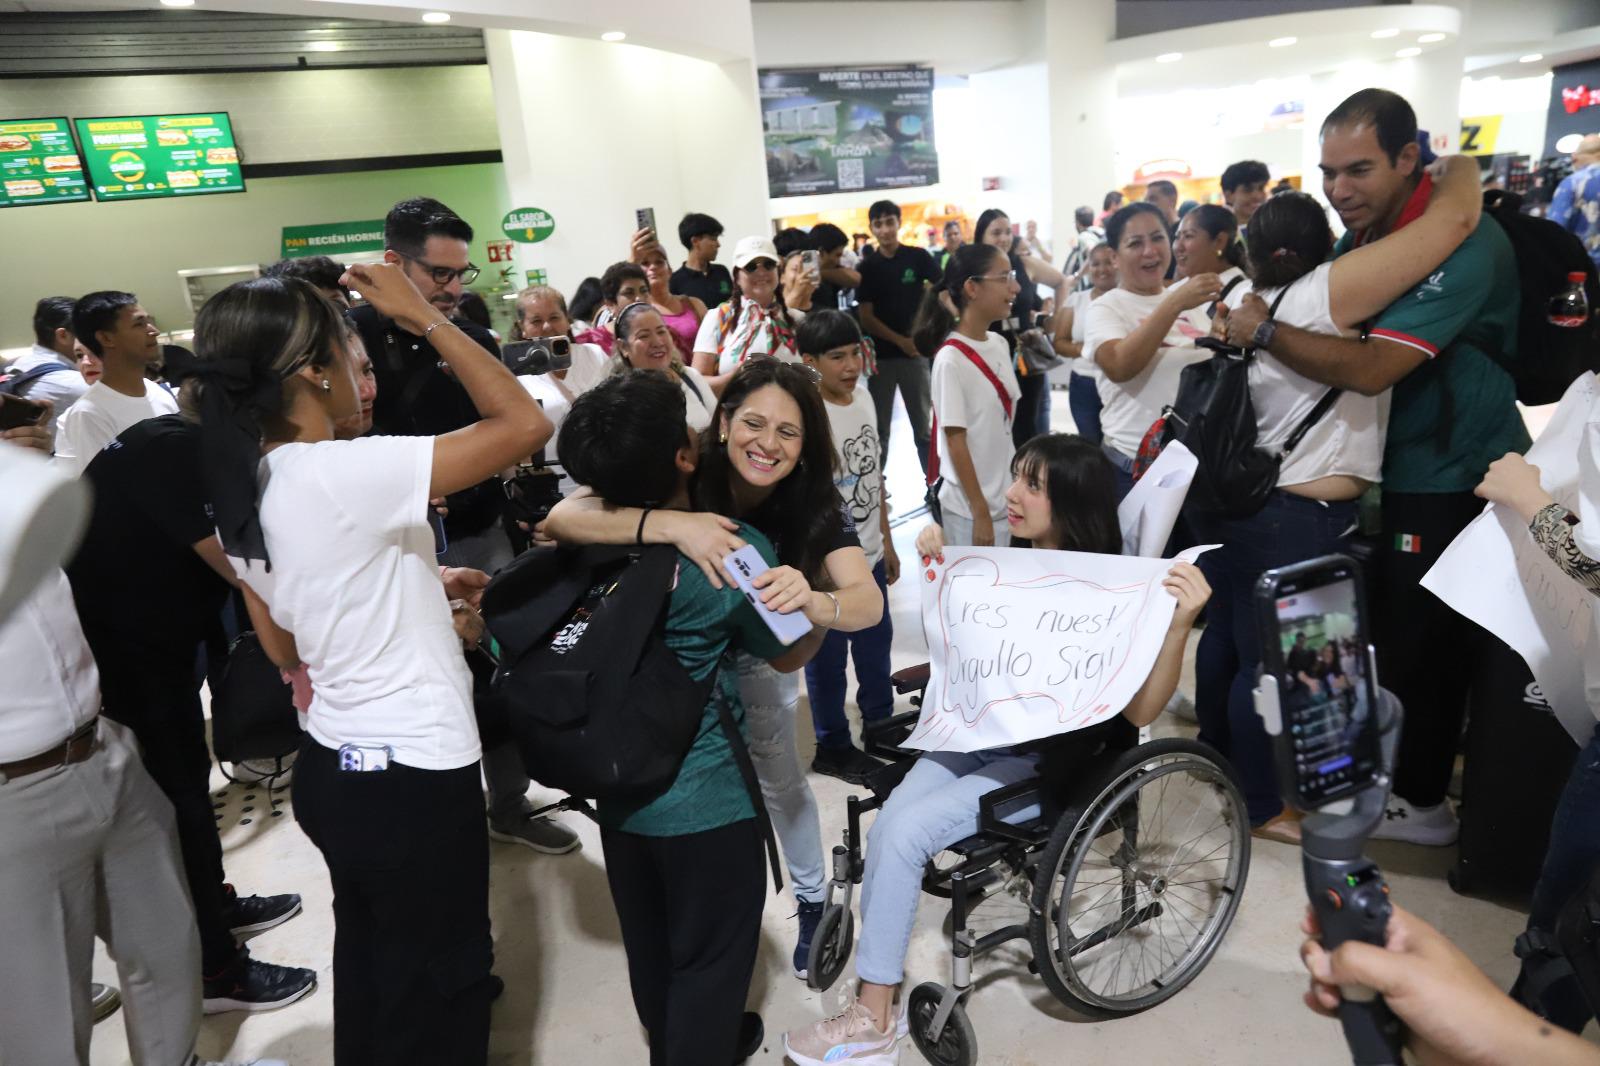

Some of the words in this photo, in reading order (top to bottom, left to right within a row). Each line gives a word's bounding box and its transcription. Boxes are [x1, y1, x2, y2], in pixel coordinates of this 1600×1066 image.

[509, 213, 519, 223] EL
[520, 212, 545, 222] SABOR
[285, 238, 306, 247] PAN
[308, 234, 345, 246] RECIÉN
